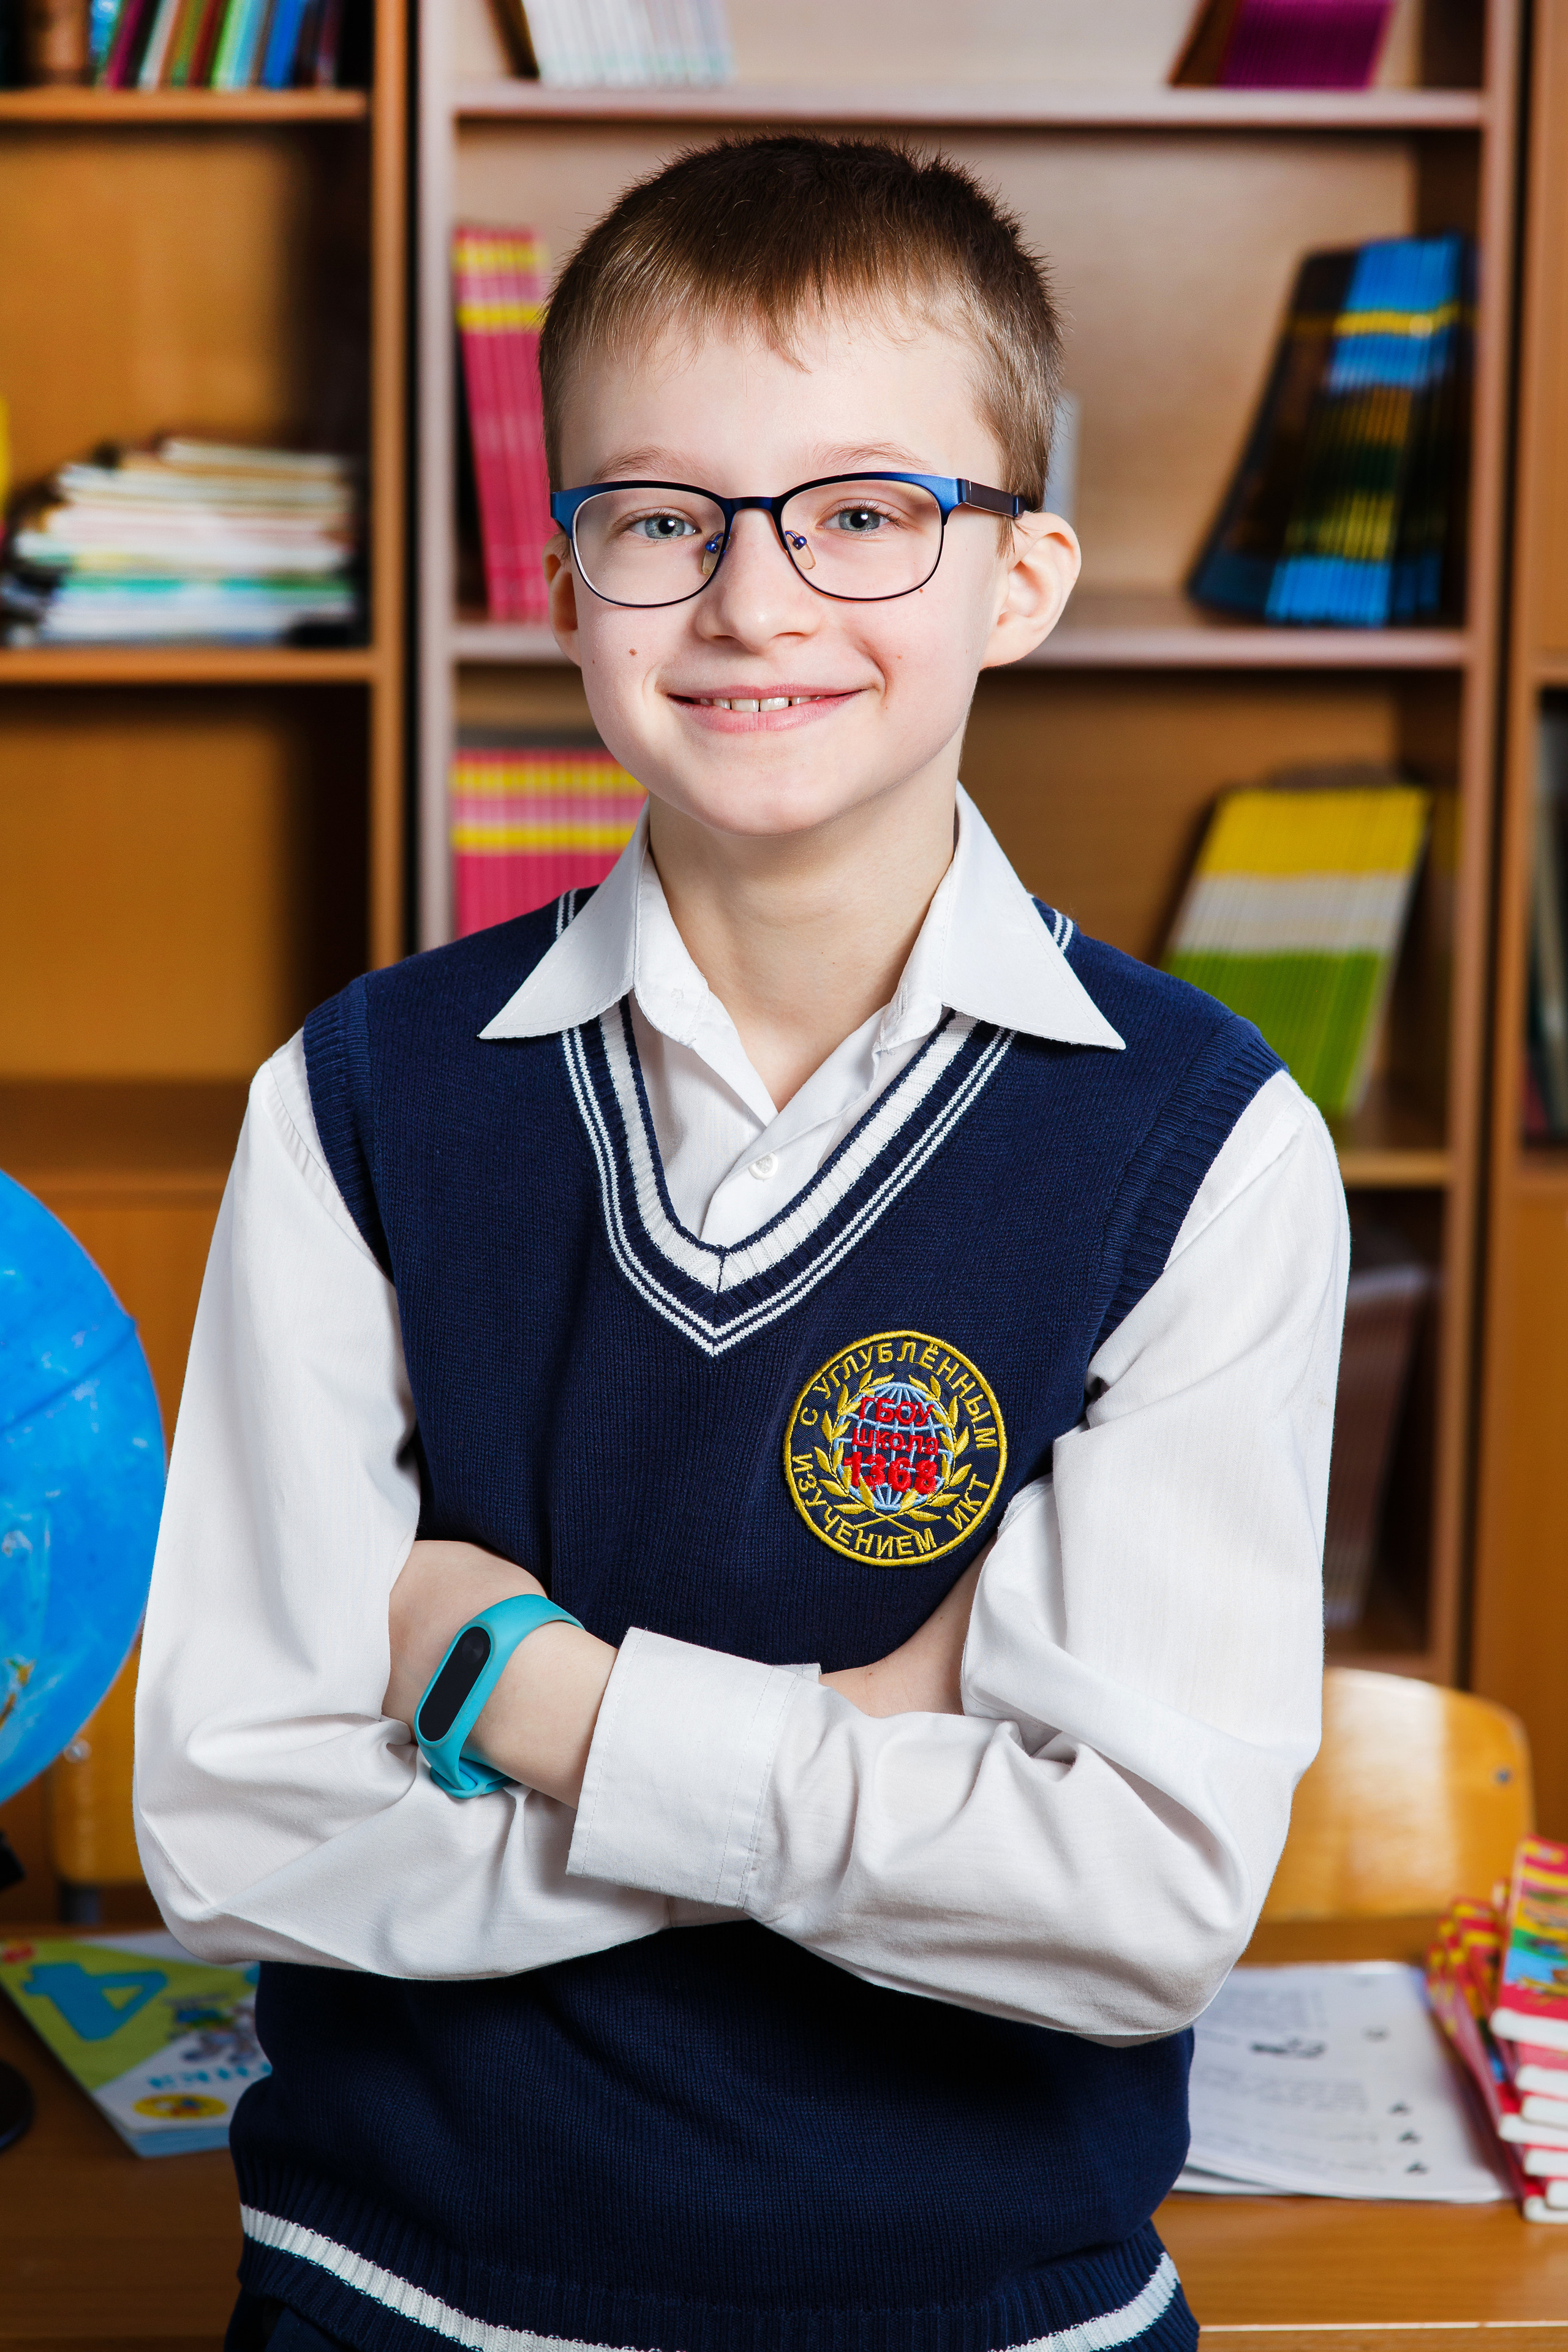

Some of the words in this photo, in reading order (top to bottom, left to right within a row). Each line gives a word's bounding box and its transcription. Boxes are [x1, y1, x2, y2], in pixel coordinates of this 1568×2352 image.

[799, 1406, 818, 1427] С
[812, 1341, 997, 1449] УГЛУБЛЁННЫМ
[859, 1396, 935, 1427] ГБОУ
[791, 1453, 937, 1558] ИЗУЧЕНИЕМ
[946, 1473, 991, 1531] ИКТ
[843, 1451, 938, 1494] 1368
